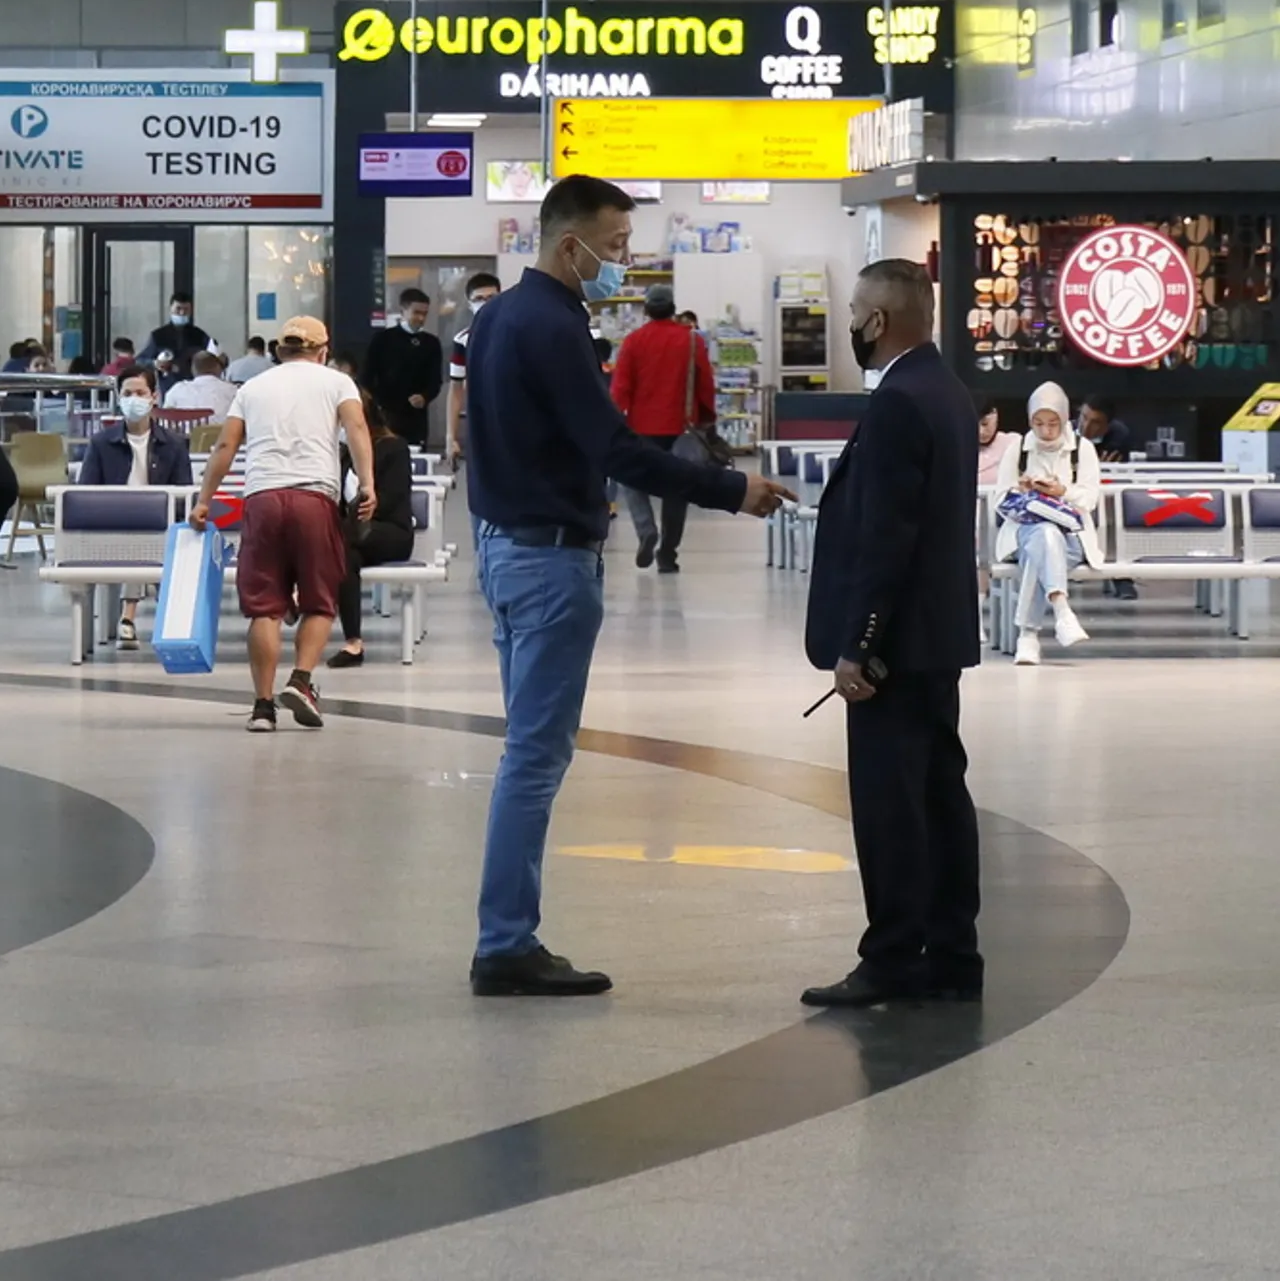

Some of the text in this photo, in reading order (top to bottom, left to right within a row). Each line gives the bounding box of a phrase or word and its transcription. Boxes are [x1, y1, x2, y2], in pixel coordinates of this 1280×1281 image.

[399, 7, 745, 64] europharma
[785, 6, 822, 55] Q
[867, 7, 941, 36] CANDY
[874, 36, 937, 64] SHOP
[500, 64, 651, 97] DÁRIHANA
[761, 55, 843, 85] COFFEE
[31, 83, 228, 99] КОРОНАВИРУСҚА ТЕСТІЛЕУ
[142, 115, 281, 140] COVID-19
[146, 152, 277, 176] TESTING
[7, 195, 252, 209] ТЕСТИРОВАНИЕ НА КОРОНАВИРУС
[1077, 232, 1173, 273] COSTA
[1070, 308, 1183, 357] COFFEE
